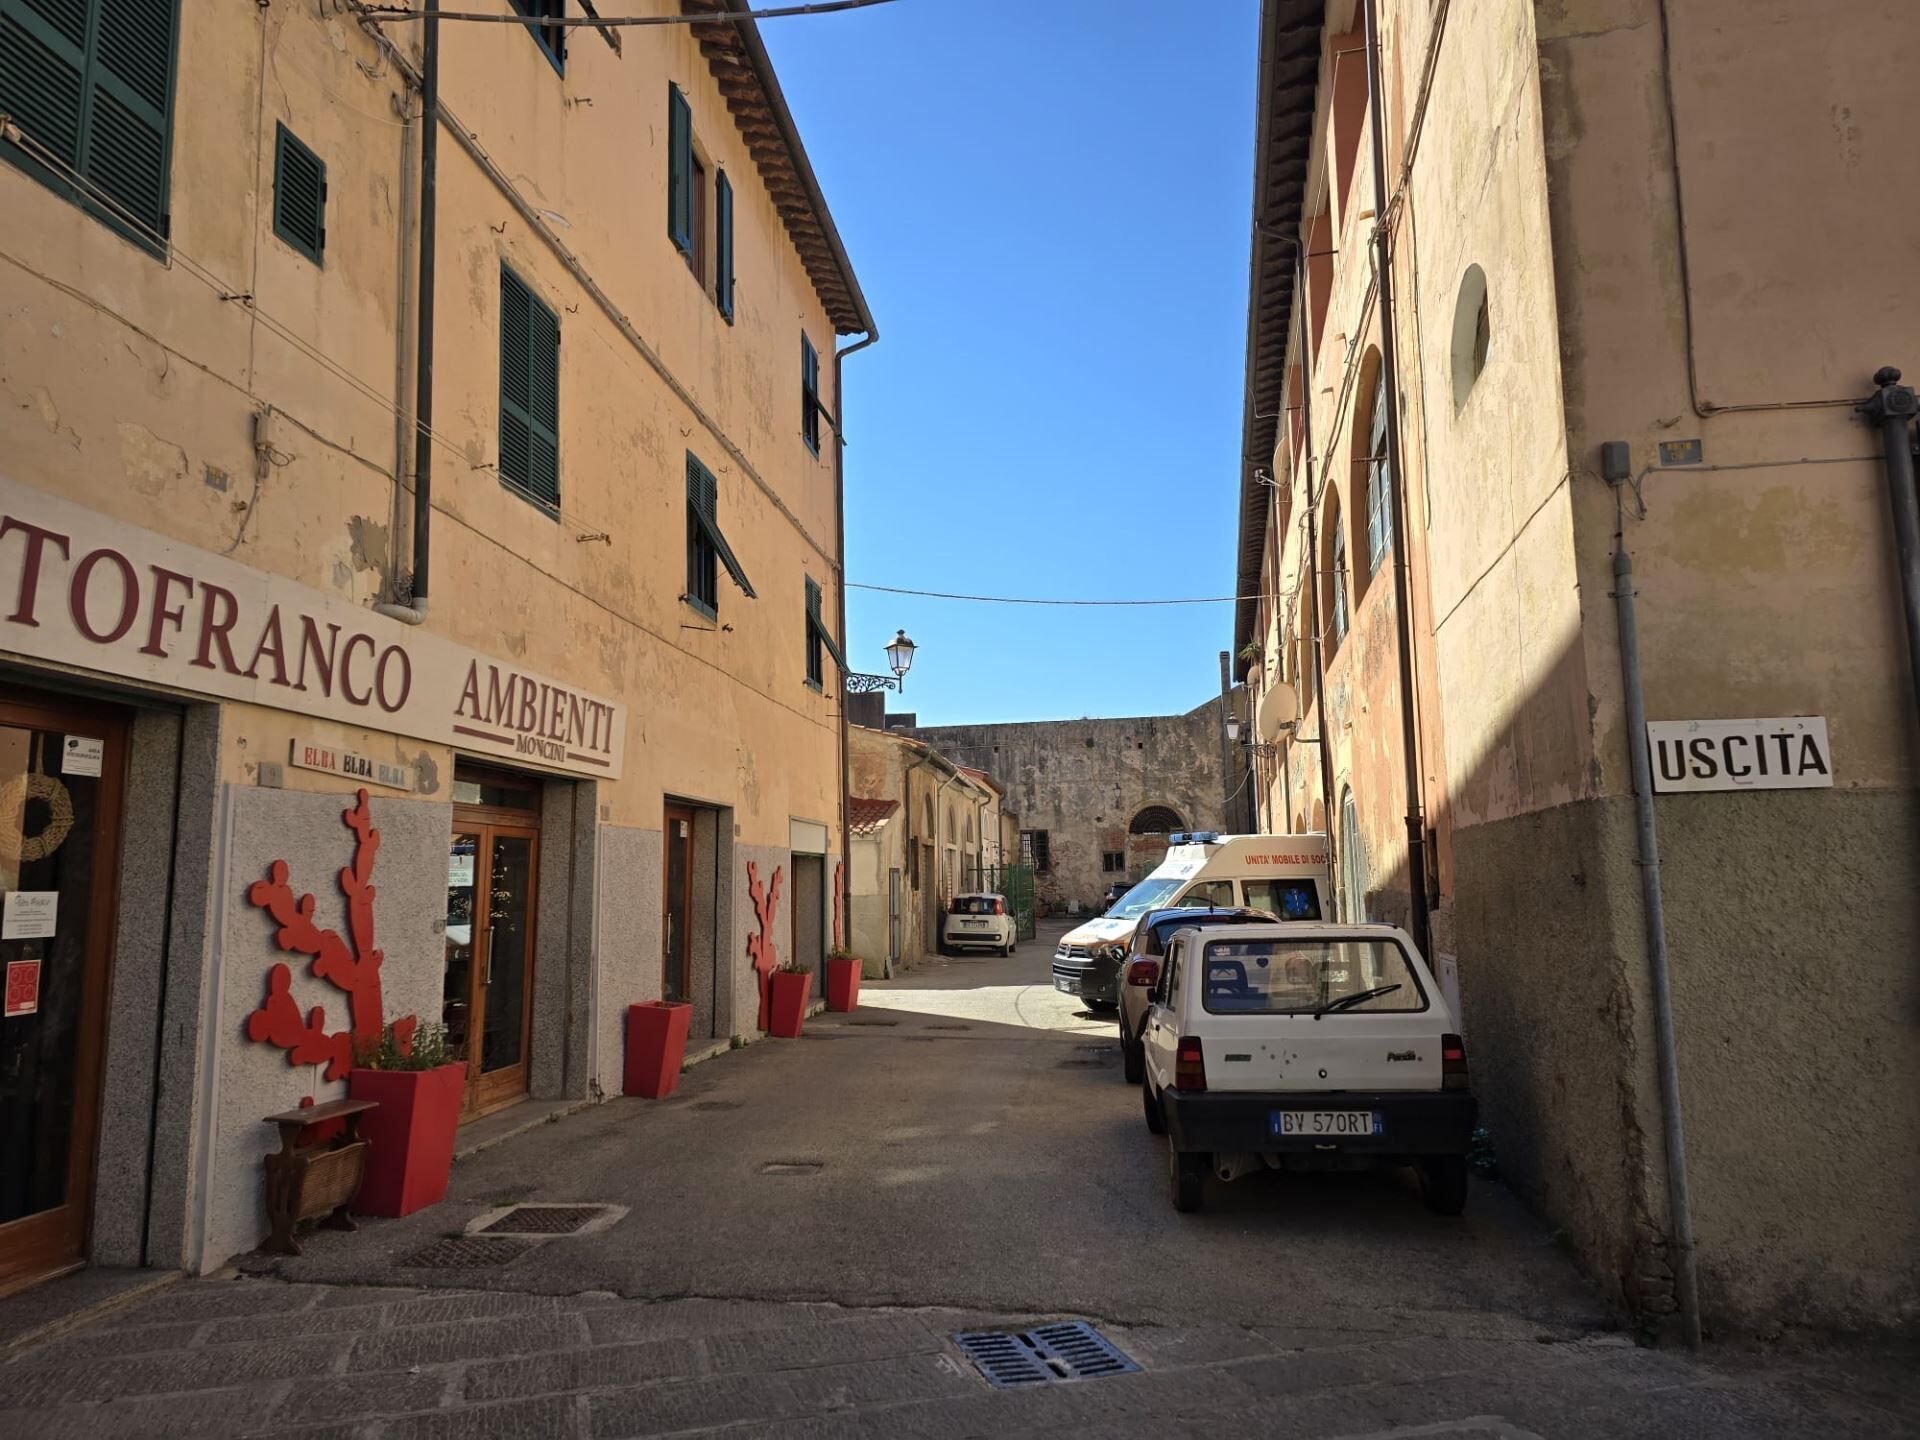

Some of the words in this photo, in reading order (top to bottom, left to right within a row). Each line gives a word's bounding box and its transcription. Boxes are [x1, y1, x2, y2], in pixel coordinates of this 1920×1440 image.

[453, 658, 615, 754] AMBIENTI
[305, 746, 336, 770] ELBA
[343, 755, 372, 778] ELBA
[516, 734, 566, 763] MONCINI
[1658, 734, 1828, 781] USCITA
[1245, 855, 1269, 865] UNITA'
[1271, 855, 1300, 865] MOBILE
[1302, 854, 1310, 864] DI
[1283, 1113, 1304, 1132] BV
